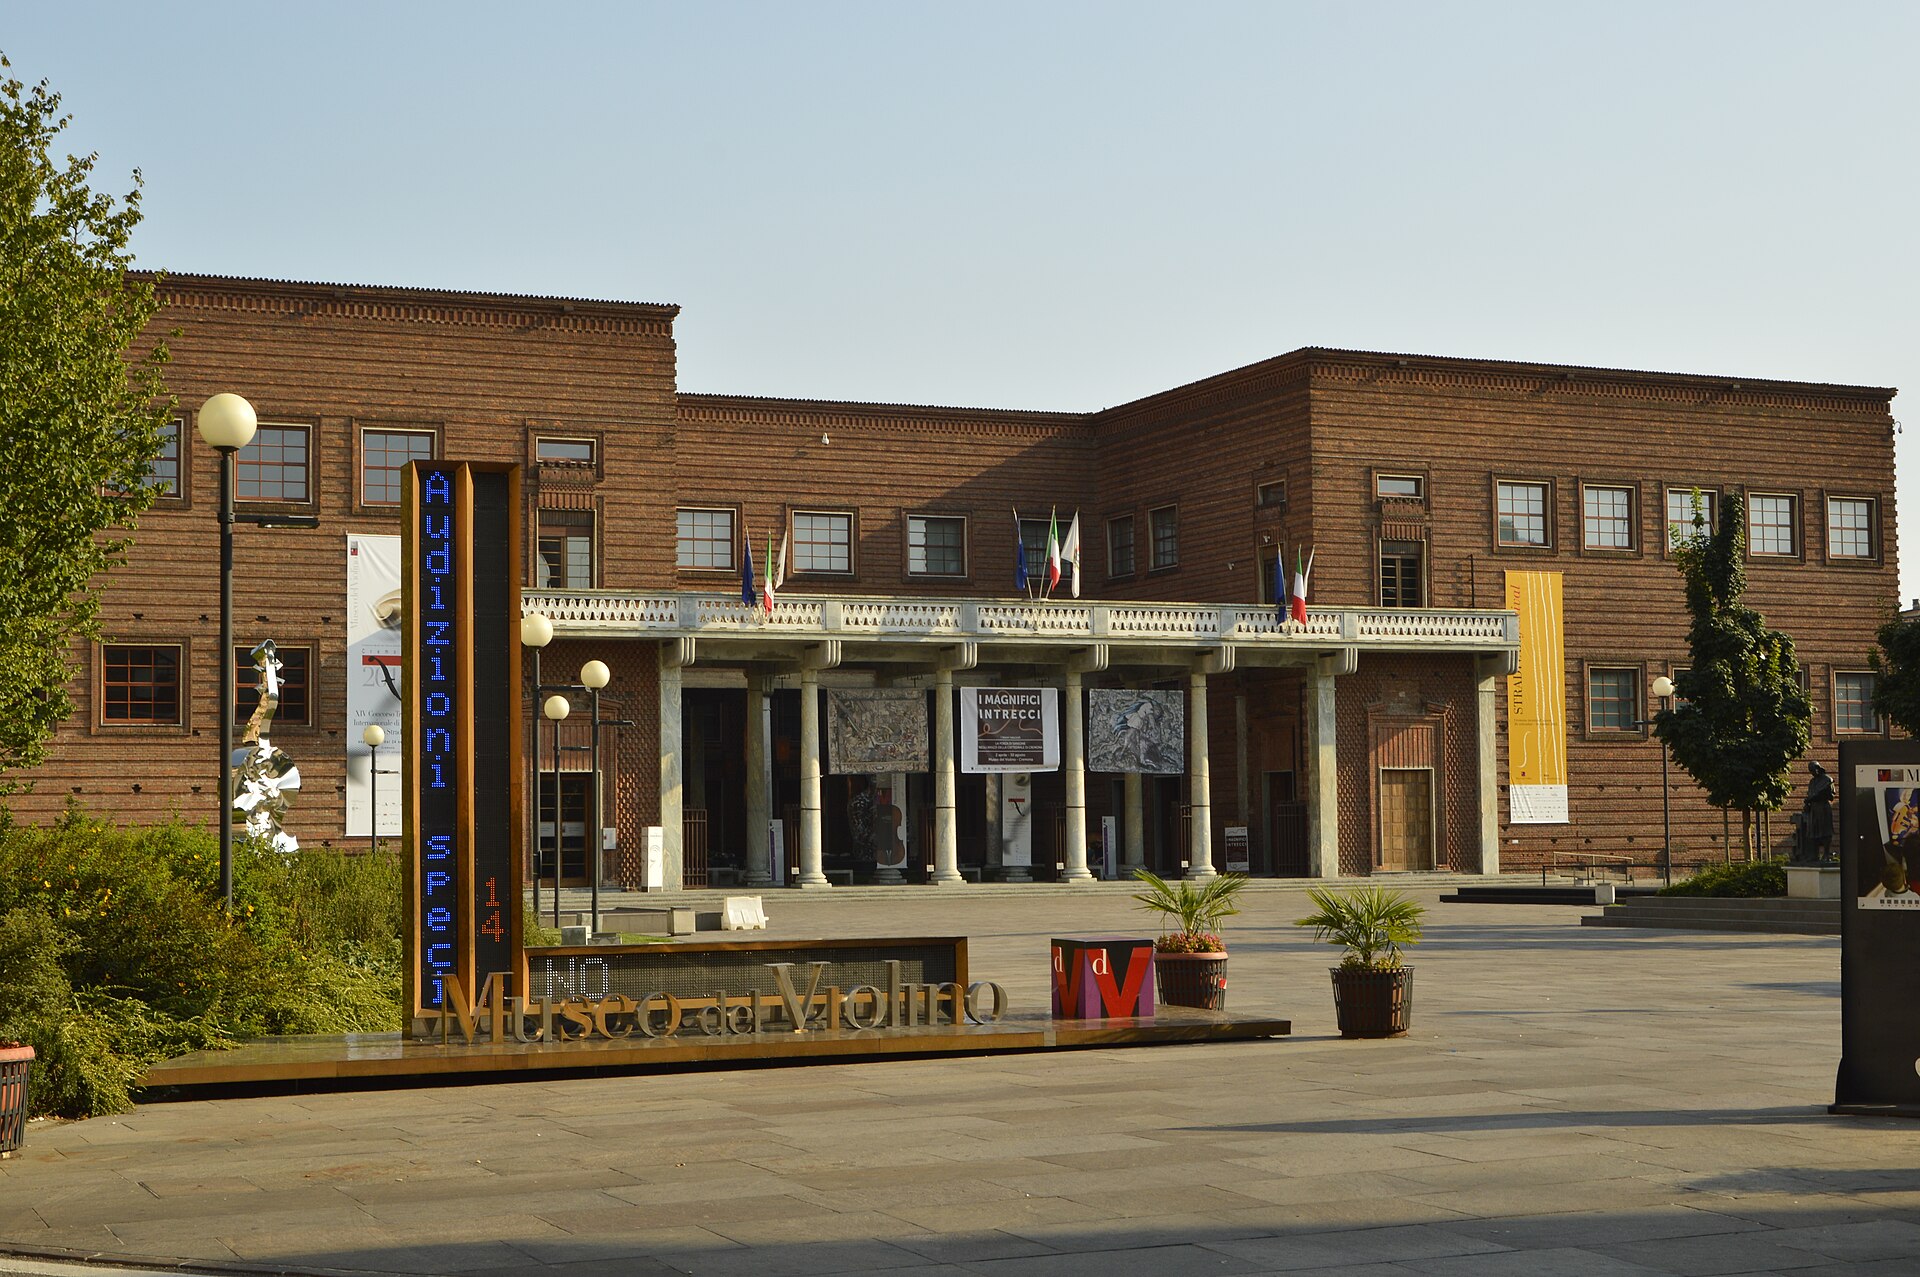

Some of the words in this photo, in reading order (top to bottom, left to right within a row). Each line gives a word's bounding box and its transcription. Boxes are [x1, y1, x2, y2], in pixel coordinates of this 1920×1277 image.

[426, 471, 450, 788] Audizioni
[979, 694, 982, 705] I
[984, 694, 1040, 705] MAGNIFICI
[979, 709, 1041, 720] INTRECCI
[546, 957, 609, 999] NO
[432, 971, 682, 1047] Museo
[697, 988, 761, 1036] del
[763, 959, 1009, 1034] Violino
